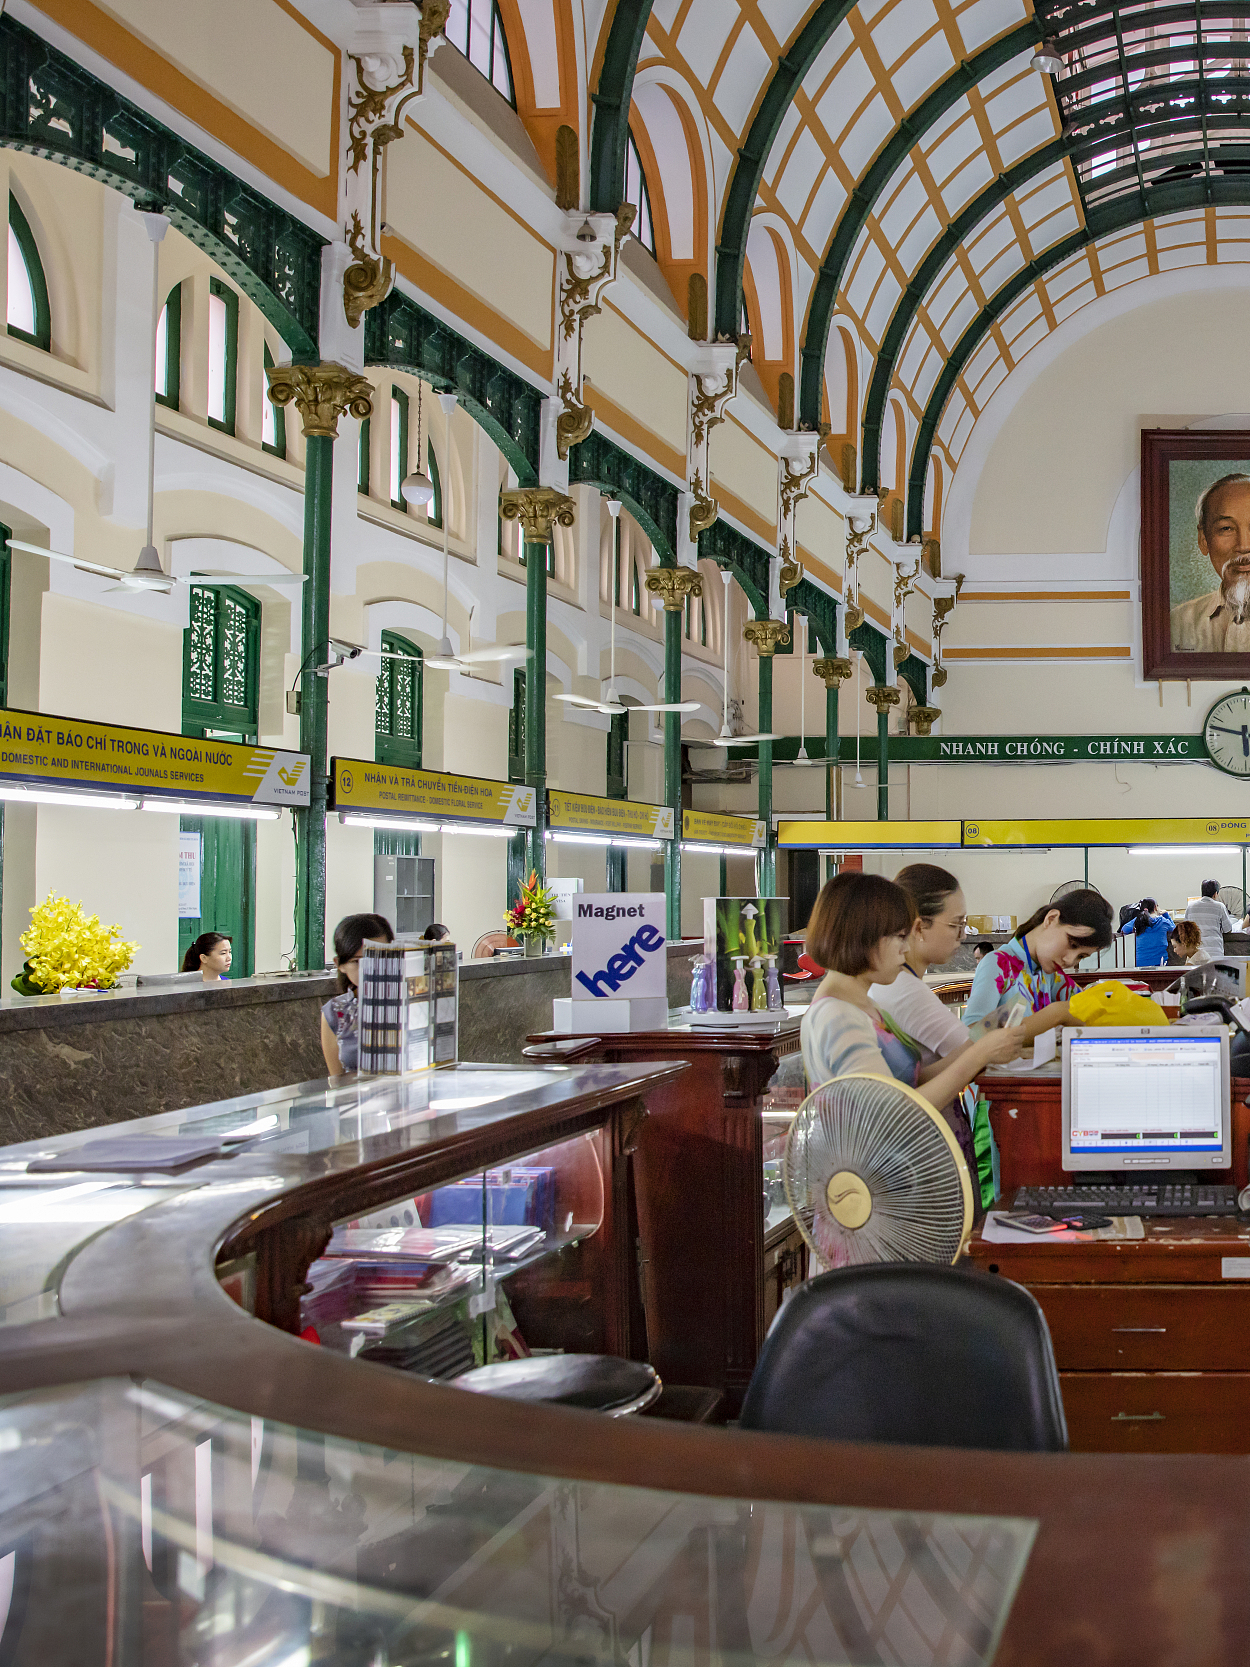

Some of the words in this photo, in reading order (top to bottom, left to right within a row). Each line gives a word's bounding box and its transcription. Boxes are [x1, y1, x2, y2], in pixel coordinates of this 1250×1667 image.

[0, 721, 21, 742] ẬN
[27, 725, 52, 746] ĐẶT
[57, 730, 83, 748] BÁO
[86, 735, 107, 750] CHÍ
[110, 739, 149, 756] TRONG
[153, 743, 167, 758] VÀ
[170, 747, 202, 762] NGOÀI
[205, 750, 233, 766] NƯỚC
[940, 742, 999, 755] NHANH
[1005, 738, 1065, 755] CHÓNG
[1087, 738, 1145, 754] CHÍNH
[1153, 737, 1189, 754] XÁC
[2, 752, 48, 766] DOMESTIC
[51, 757, 69, 769] AND
[71, 760, 133, 775] INTERNATIONAL
[135, 767, 168, 779] JOUNALS
[170, 771, 204, 783] SERVICES
[343, 777, 351, 787] 12
[364, 772, 387, 785] NHẬN
[389, 774, 399, 785] VÀ
[401, 775, 415, 788] TRẢ
[417, 777, 446, 791] CHUYỂN
[480, 788, 493, 797] HOA
[274, 788, 296, 796] VIETNAM
[379, 791, 397, 800] POSTAL
[467, 801, 483, 809] SERVICE
[1221, 821, 1247, 829] ĐÓNG
[578, 903, 645, 921] Magnet
[575, 924, 665, 997] here
